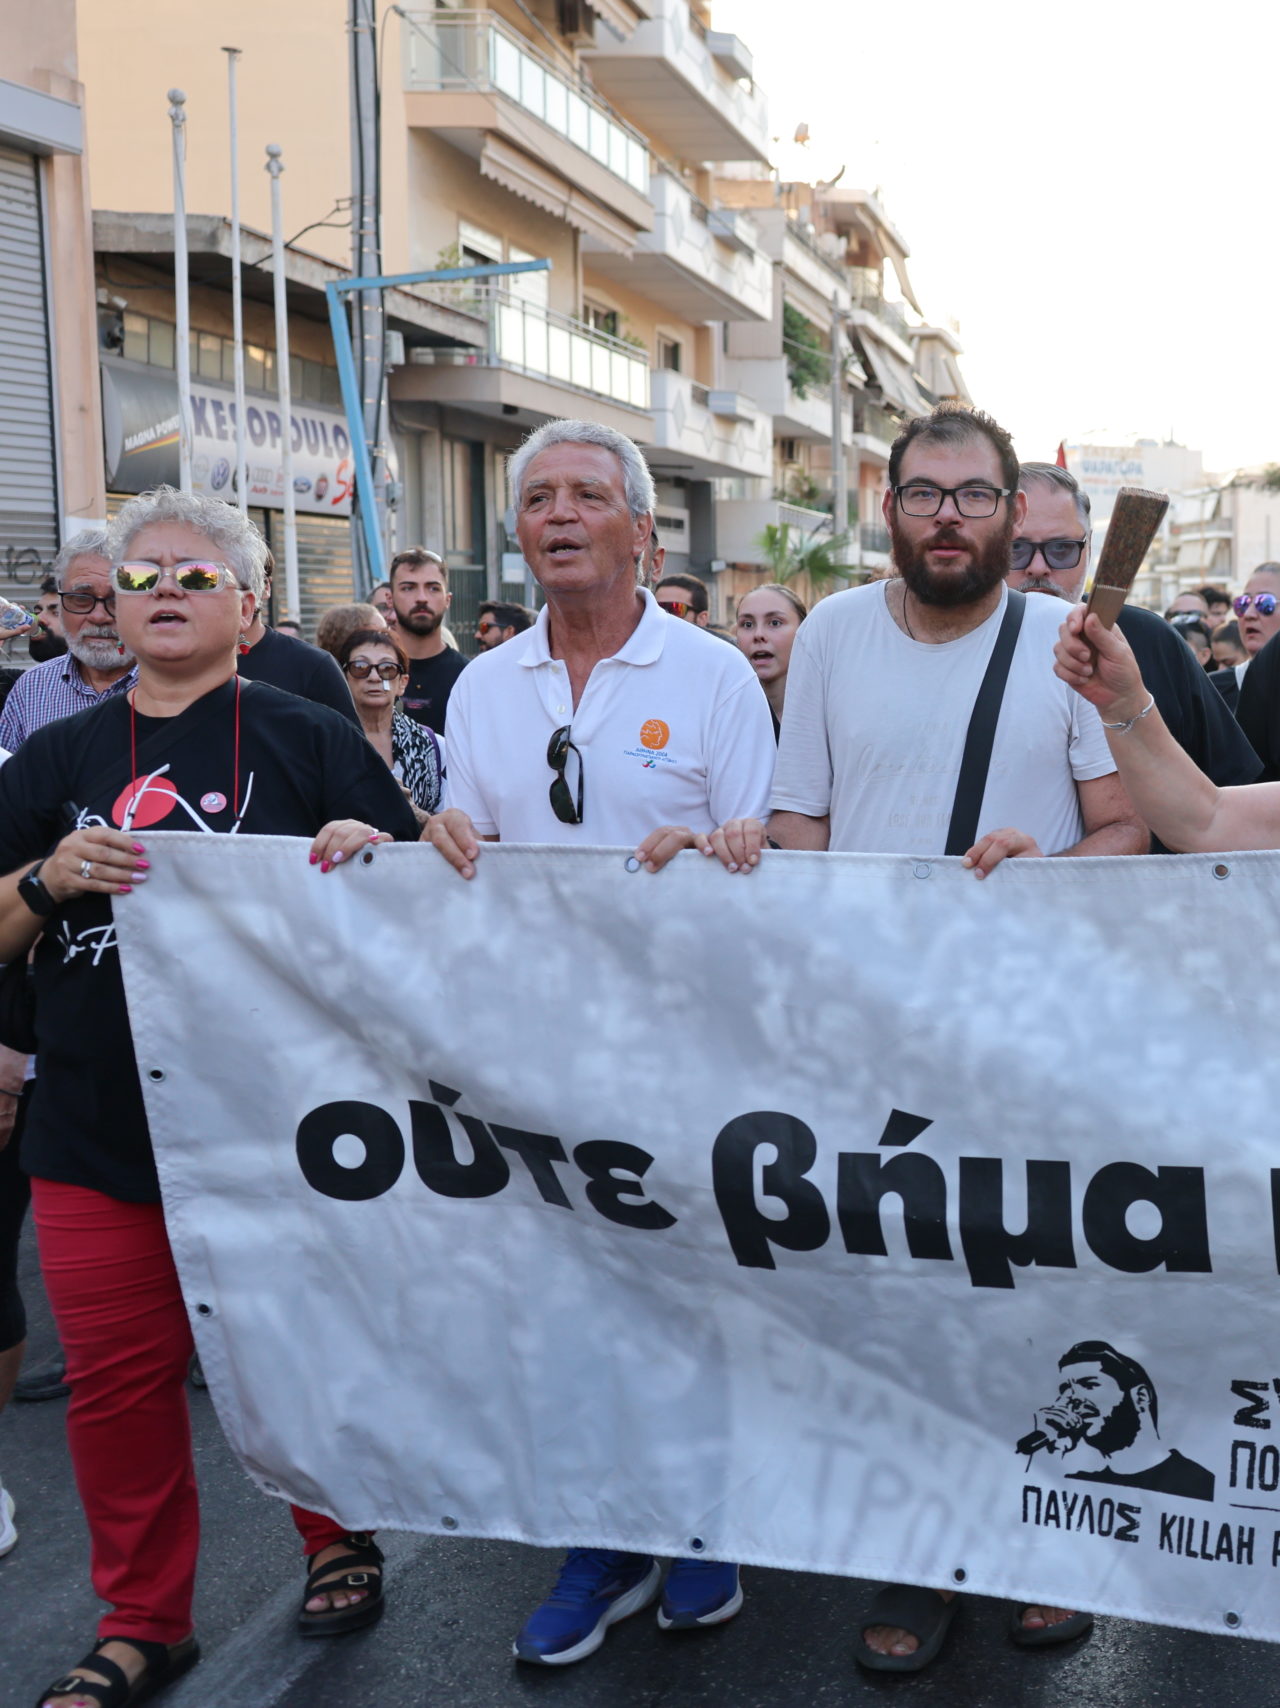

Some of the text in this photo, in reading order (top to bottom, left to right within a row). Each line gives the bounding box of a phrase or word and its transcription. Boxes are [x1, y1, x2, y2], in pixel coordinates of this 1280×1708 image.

[124, 426, 156, 451] MAGNA
[296, 1079, 678, 1230] ούτε
[711, 1108, 1213, 1290] βήμα
[1022, 1485, 1141, 1542] ΠΑΥΛΟΣ
[1159, 1513, 1255, 1565] KILLAH
